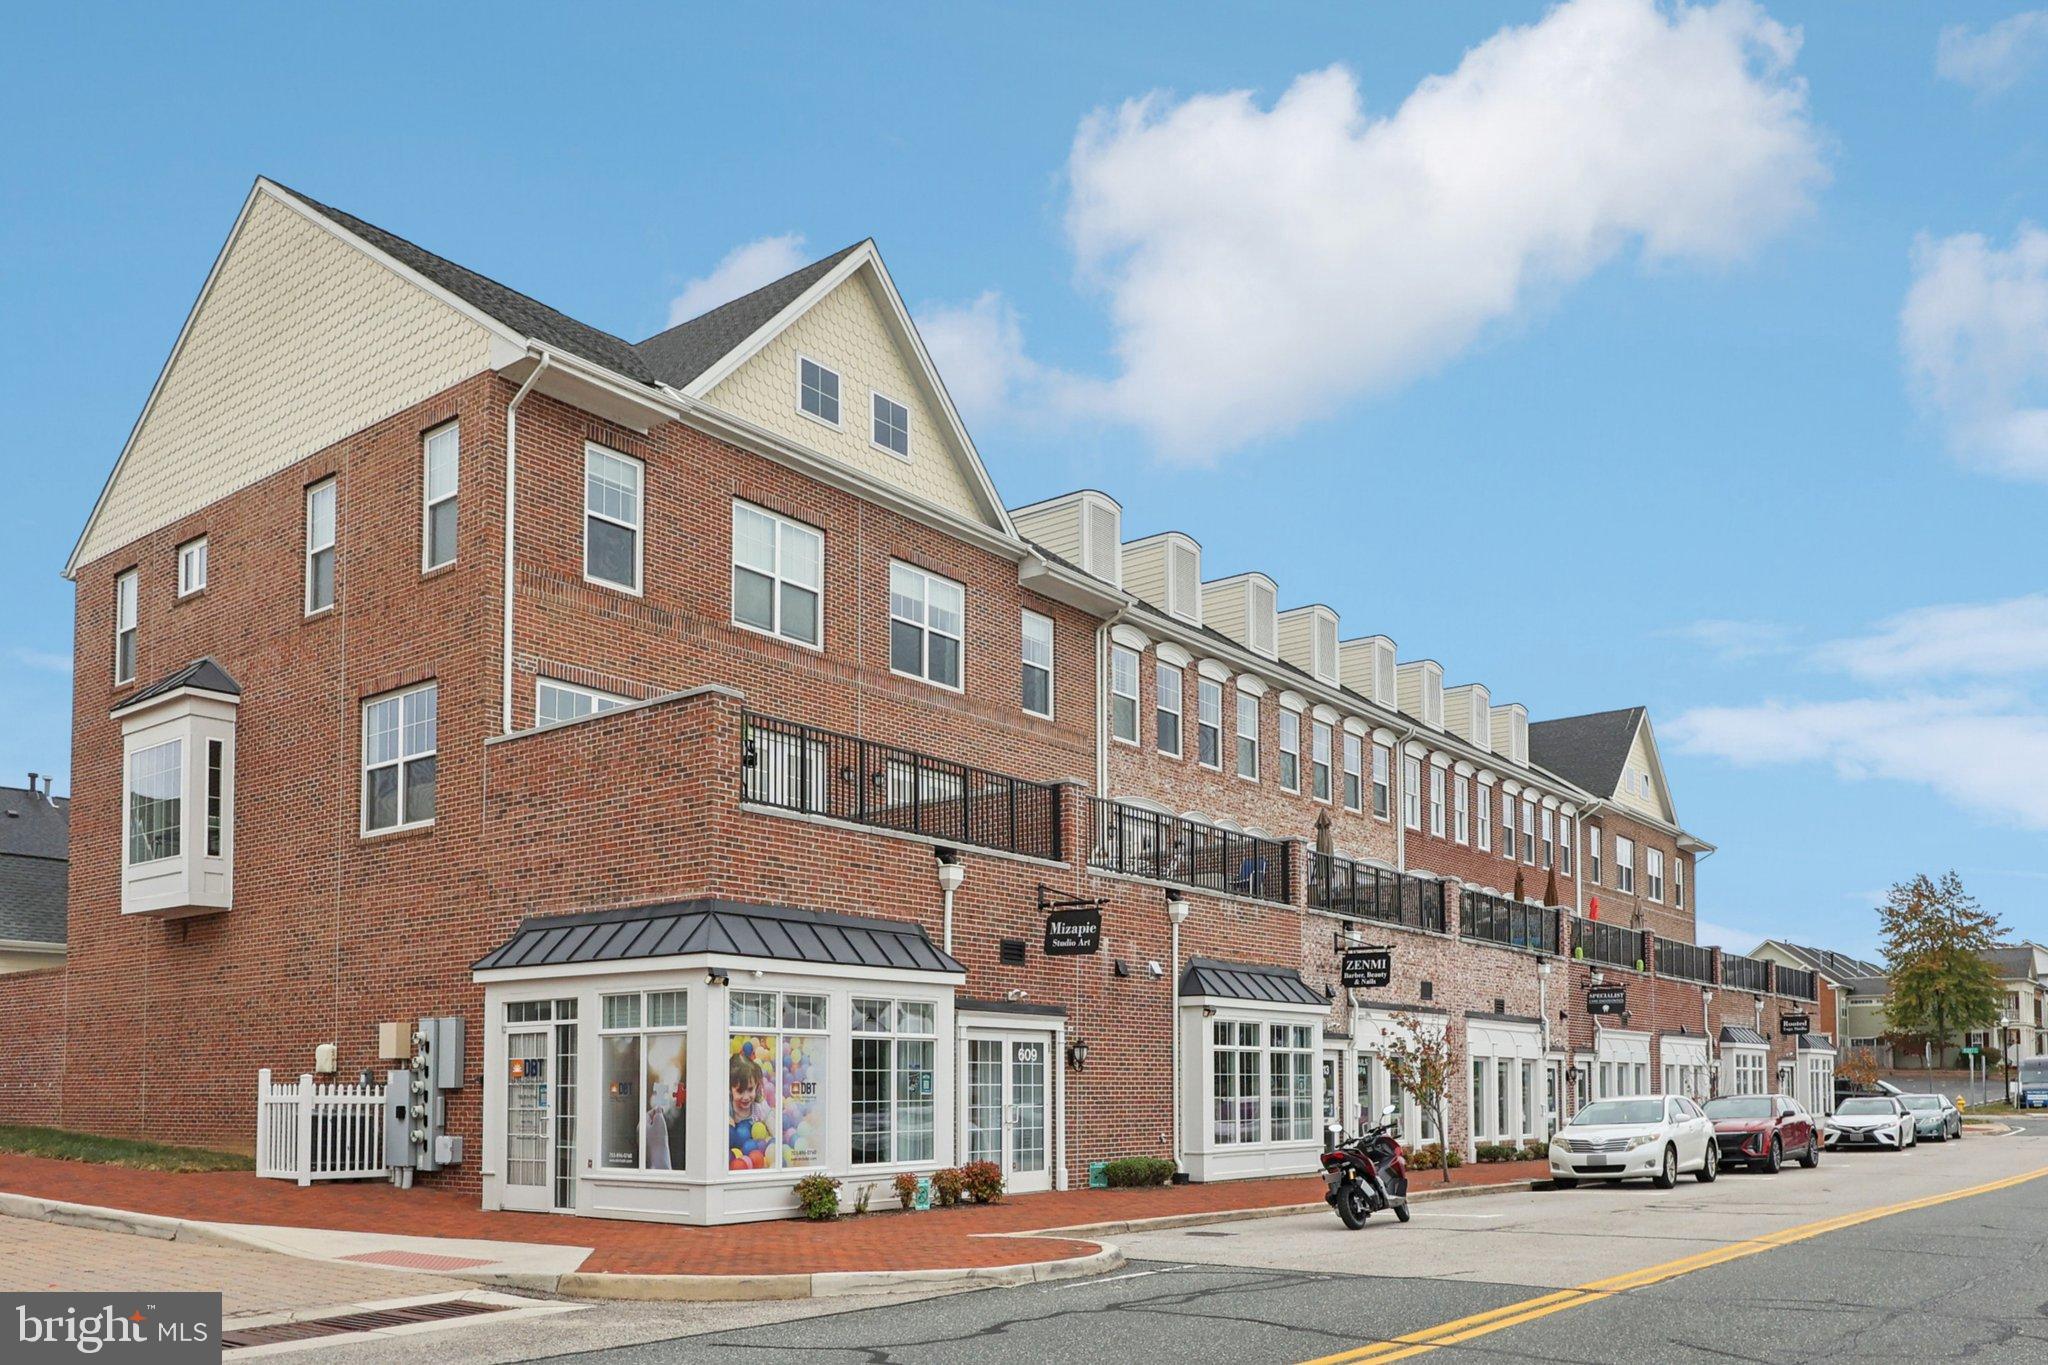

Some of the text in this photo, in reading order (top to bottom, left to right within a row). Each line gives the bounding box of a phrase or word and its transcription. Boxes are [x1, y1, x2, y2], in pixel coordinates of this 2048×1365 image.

[1050, 921, 1097, 937] Mizapie
[1052, 938, 1091, 947] Studio Art
[1346, 959, 1387, 970] ZENMI
[1367, 971, 1387, 979] Beauty
[1018, 1048, 1037, 1061] 609
[524, 1059, 544, 1077] DBT
[619, 1082, 632, 1095] DBT
[801, 1082, 816, 1094] DBT
